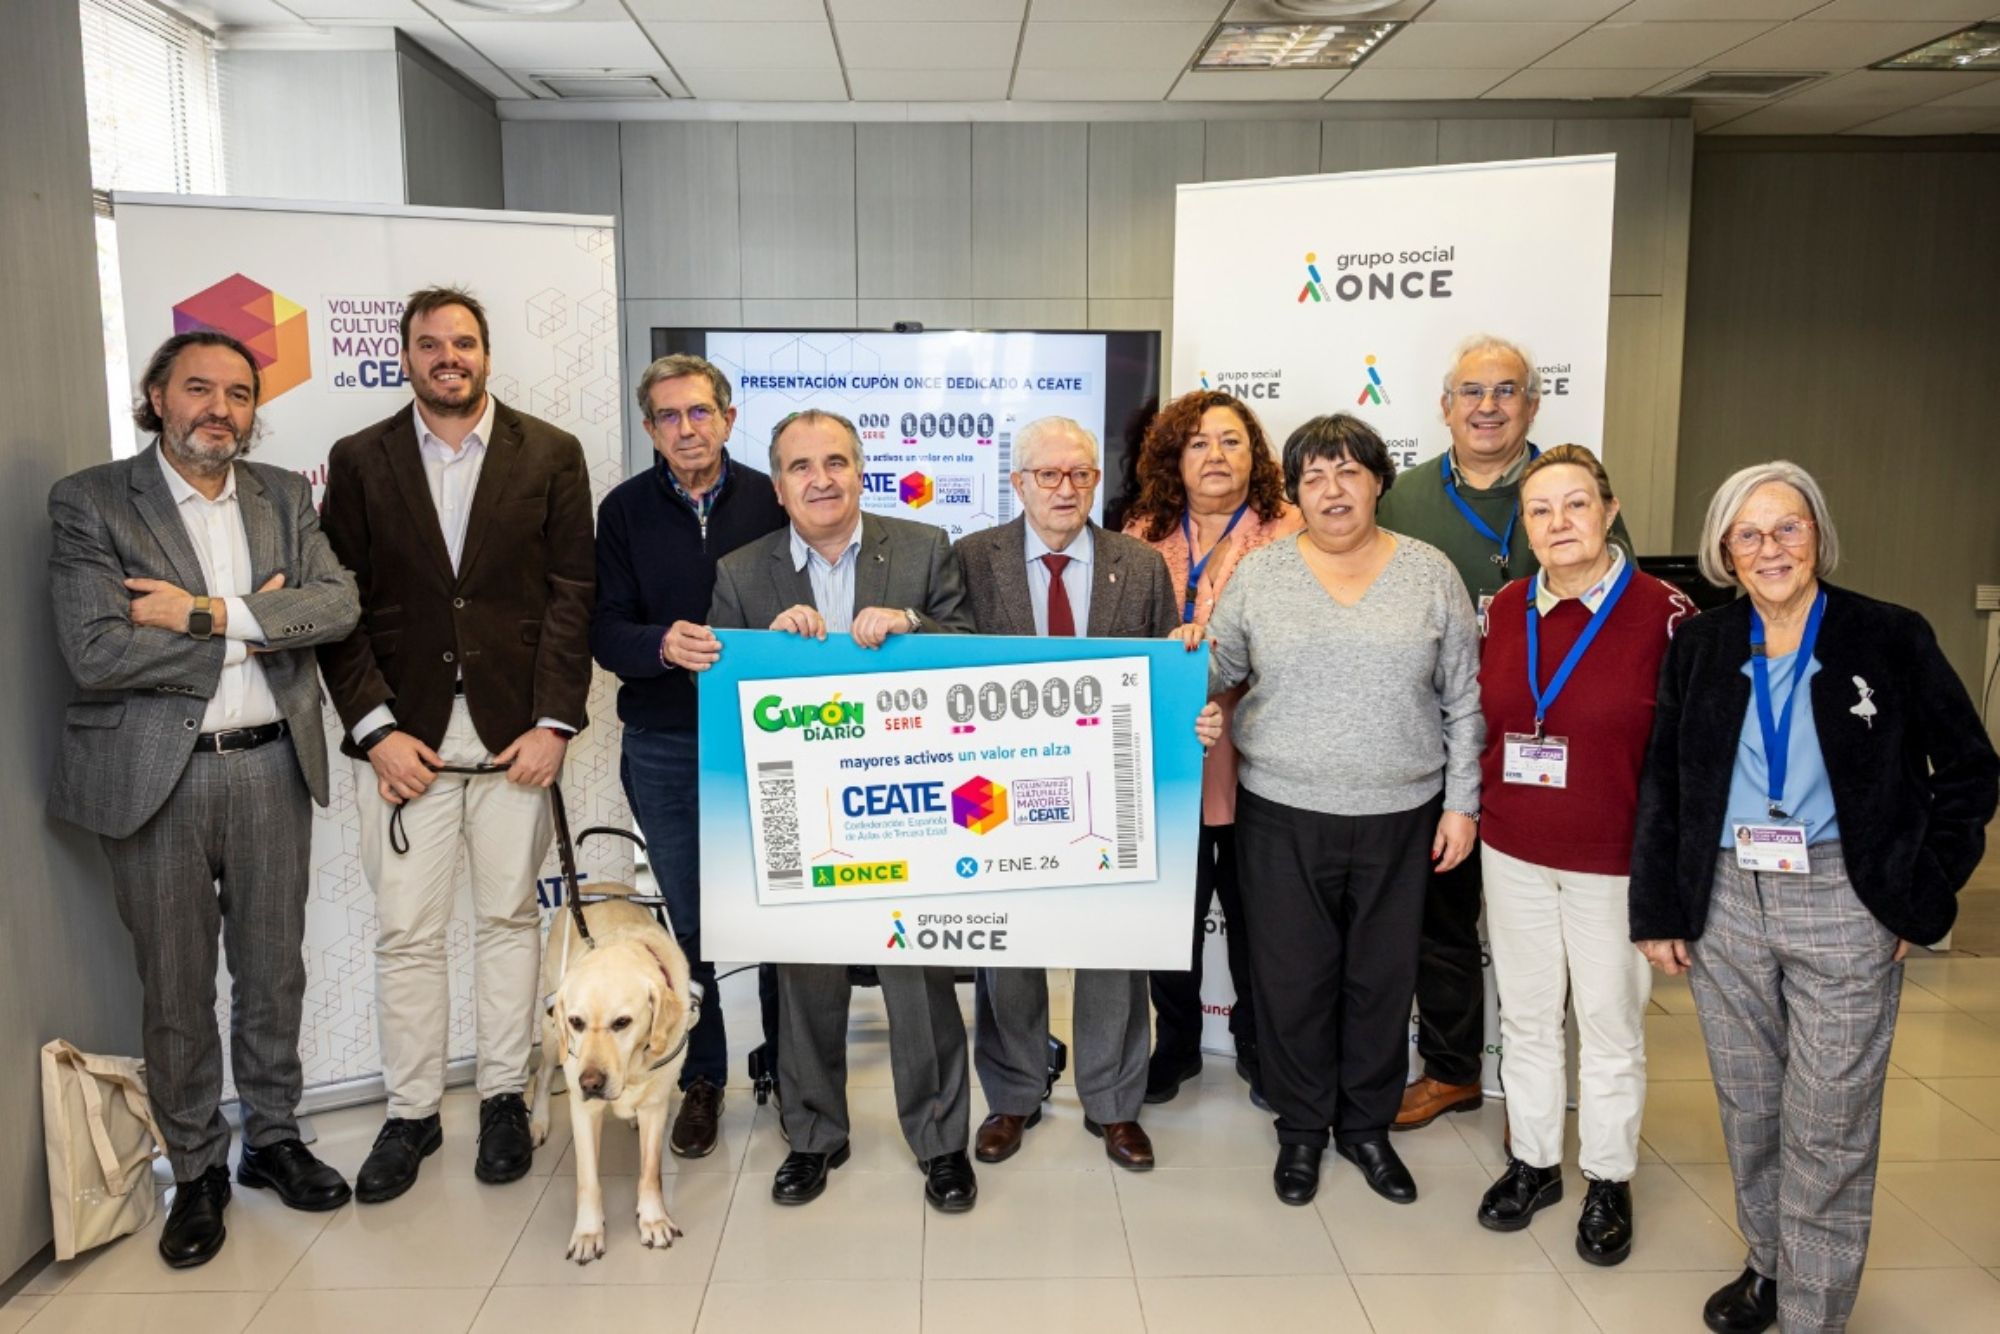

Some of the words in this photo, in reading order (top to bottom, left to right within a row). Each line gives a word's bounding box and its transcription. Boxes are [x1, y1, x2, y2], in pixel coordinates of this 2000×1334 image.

[1337, 252, 1394, 271] grupo
[1399, 245, 1455, 263] social
[1336, 270, 1453, 302] ONCE
[328, 300, 405, 315] VOLUNTA
[330, 318, 400, 334] CULTUR
[332, 336, 400, 357] MAYO
[334, 371, 356, 387] de
[741, 373, 847, 389] PRESENTACIÓN
[852, 373, 899, 389] CUPÓN
[904, 376, 942, 389] ONCE
[946, 376, 1018, 390] DEDICADO
[1023, 377, 1032, 390] A
[1037, 377, 1083, 391] CEATE
[1217, 371, 1249, 381] grupo
[1251, 368, 1281, 379] social
[1541, 378, 1569, 396] CE
[859, 413, 890, 428] 000
[901, 412, 994, 438] 00000
[862, 430, 886, 439] SERIE
[1386, 437, 1419, 448] social
[863, 472, 897, 493] ATE
[876, 687, 928, 713] 000
[946, 675, 1103, 723] 00000
[1122, 672, 1139, 687] 2€
[885, 716, 923, 731] SERIE
[840, 756, 900, 771] mayores
[904, 750, 954, 766] activos
[958, 751, 977, 762] un
[980, 746, 1020, 760] valor
[1021, 747, 1038, 758] en
[1042, 742, 1071, 756] alza
[842, 781, 947, 818] CEATE
[1016, 797, 1070, 808] MAYORES
[1029, 807, 1070, 822] CEATE
[840, 864, 904, 882] ONCE
[984, 860, 993, 873] 7
[999, 857, 1038, 872] ENE.
[1040, 855, 1060, 869] 26
[917, 913, 963, 926] grupo
[966, 912, 1008, 924] social
[917, 929, 1008, 951] ONCE
